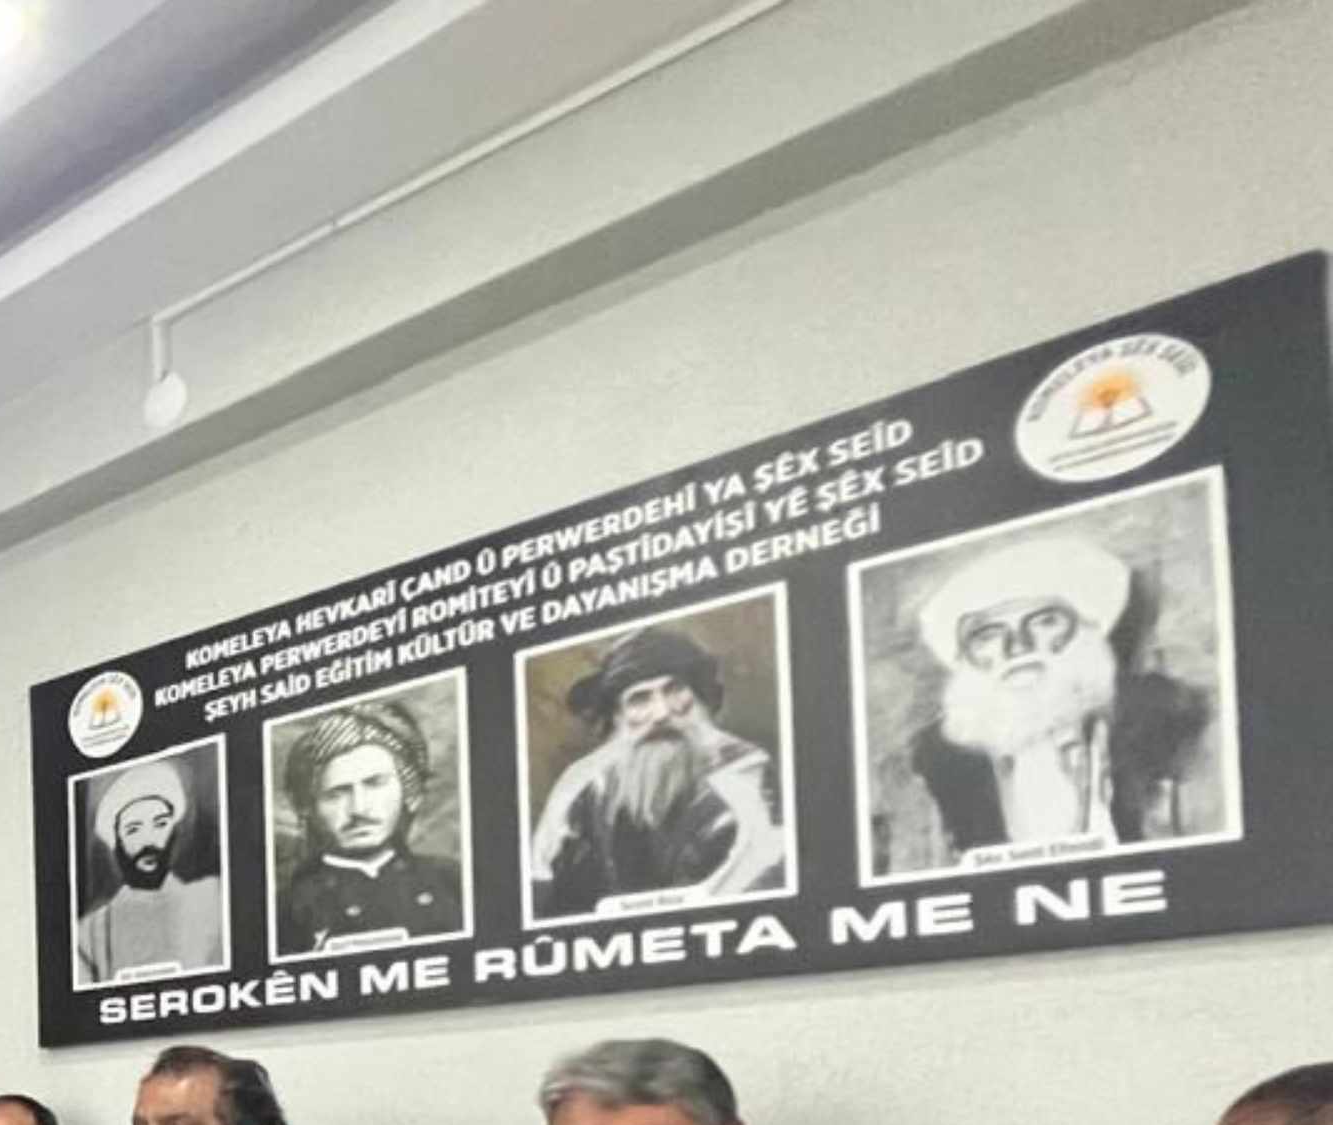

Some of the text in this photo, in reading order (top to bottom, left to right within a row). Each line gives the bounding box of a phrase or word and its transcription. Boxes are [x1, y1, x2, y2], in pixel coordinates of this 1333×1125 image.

[154, 660, 258, 707] KOMELEYA
[763, 485, 810, 524] YÊ
[185, 618, 292, 670] KOMELEYA
[400, 558, 472, 602] ÇAND
[703, 472, 746, 505] YA
[204, 688, 257, 722] ŞEYH
[397, 617, 495, 665] KÜLTÜR
[499, 605, 537, 636] VE
[541, 555, 718, 626] DAYANIŞMA
[724, 501, 881, 575] DERNEĞİ
[99, 870, 1169, 1025] SEROKÊN ME RÛMETA ME NE
